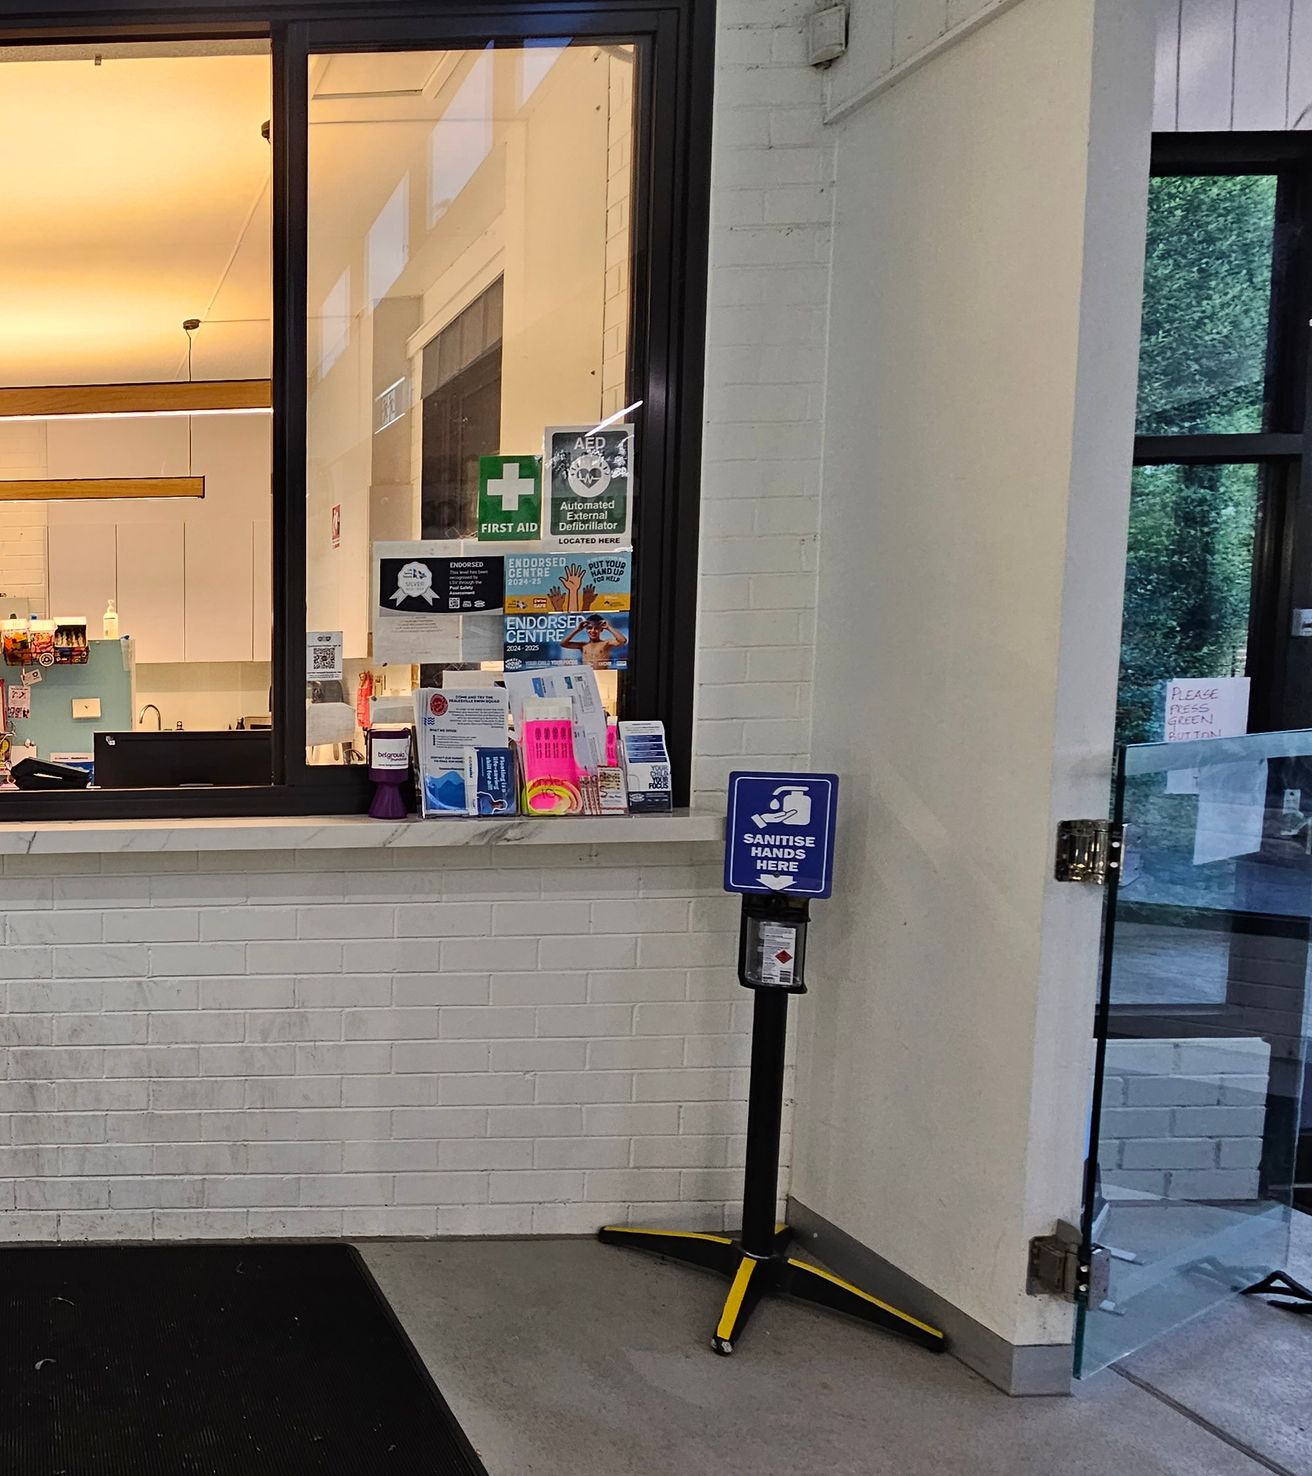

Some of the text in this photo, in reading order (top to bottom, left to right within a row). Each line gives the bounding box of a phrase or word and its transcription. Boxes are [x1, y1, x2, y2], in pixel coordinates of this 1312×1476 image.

[574, 436, 605, 450] AED
[560, 500, 615, 510] Automated
[567, 511, 608, 520] External
[482, 522, 538, 533] FIRST AID
[559, 522, 617, 531] Defibrillator
[508, 557, 566, 568] ENDORSED
[588, 560, 626, 570] PUT YOUR
[508, 567, 550, 578] CENTRE
[591, 568, 612, 577] HAND
[508, 578, 541, 586] 2024-25
[507, 616, 587, 630] ENDORSED
[506, 630, 565, 643] CENTRE
[1172, 686, 1219, 701] PLEASE
[1170, 703, 1210, 715] PRESS
[1168, 714, 1213, 727] GREEN
[499, 756, 507, 781] Floating
[743, 834, 815, 847] SANITISE
[751, 847, 806, 860] HANDS
[756, 860, 798, 872] HERE
